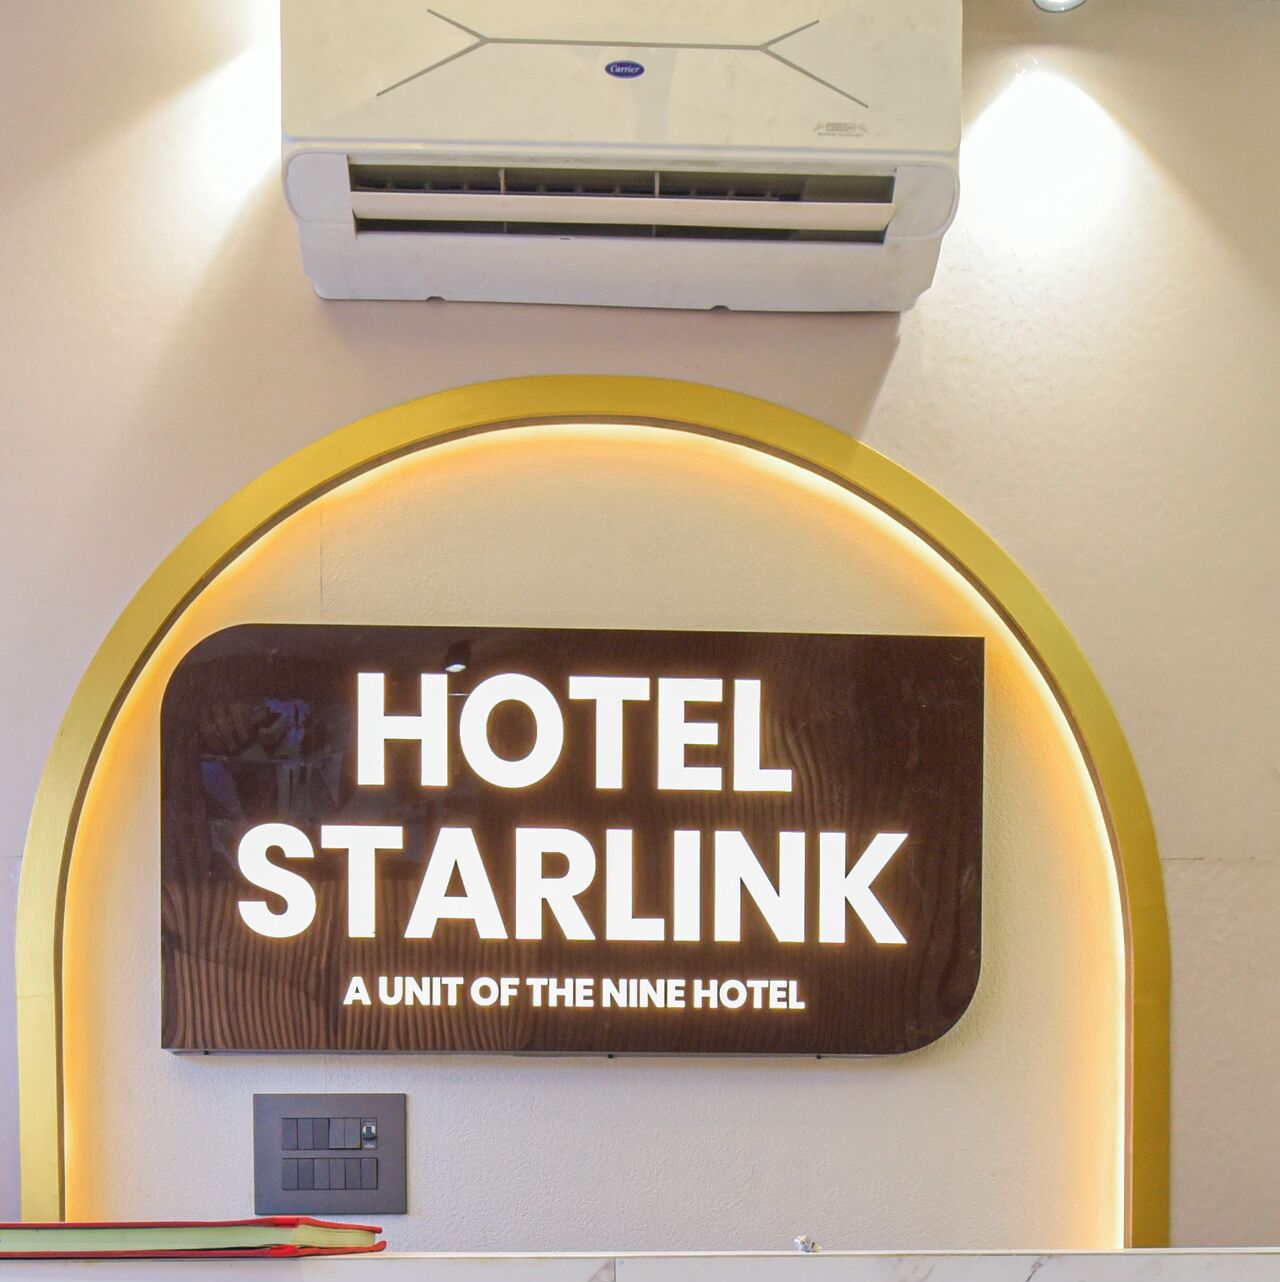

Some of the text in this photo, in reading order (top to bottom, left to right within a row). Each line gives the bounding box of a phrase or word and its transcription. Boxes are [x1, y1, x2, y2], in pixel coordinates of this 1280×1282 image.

[609, 64, 641, 73] Carrier
[356, 672, 793, 792] HOTEL
[237, 823, 909, 945] STARLINK
[343, 976, 806, 1010] A UNIT OF THE NINE HOTEL
